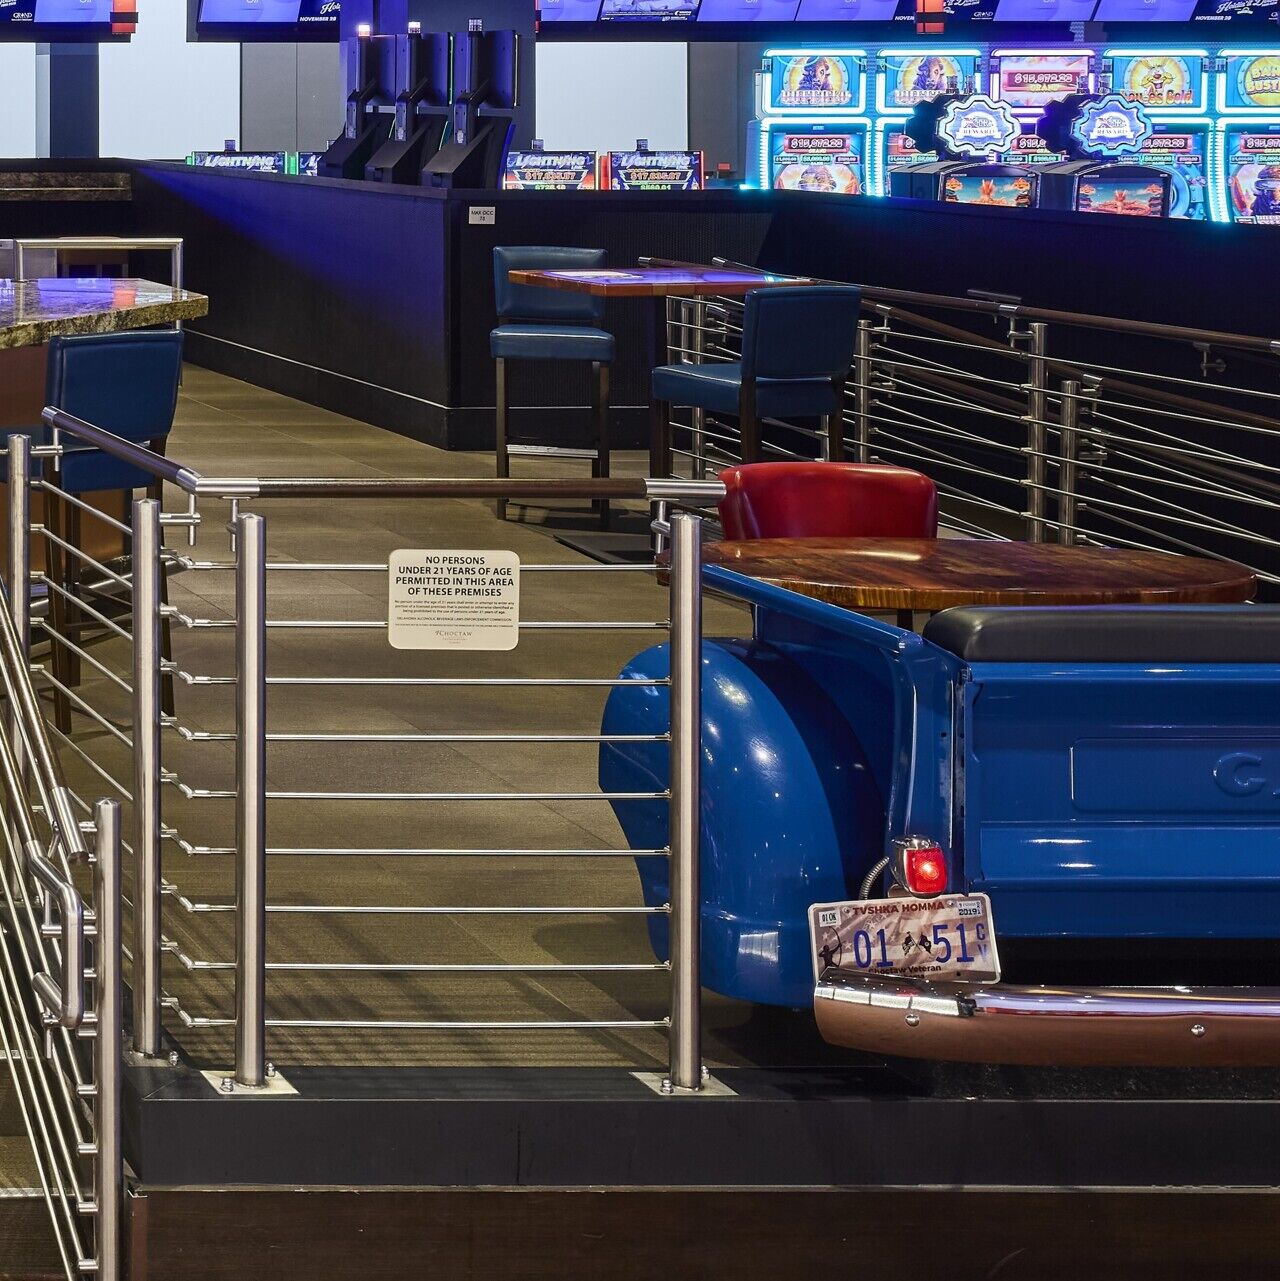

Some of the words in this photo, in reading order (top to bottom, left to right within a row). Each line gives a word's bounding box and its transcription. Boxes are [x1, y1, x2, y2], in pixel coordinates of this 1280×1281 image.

[425, 556, 440, 564] NO
[442, 556, 485, 565] PERSONS
[447, 567, 475, 575] YEARS
[396, 577, 450, 585] PERMITTED
[465, 578, 486, 586] THIS
[489, 578, 514, 586] AREA
[408, 587, 421, 595] OF
[455, 588, 502, 596] PREMISES
[853, 905, 899, 915] TVSHKA
[902, 902, 945, 912] HOMMA
[958, 908, 977, 916] 2019
[853, 929, 894, 968] 01
[932, 923, 974, 964] 51
